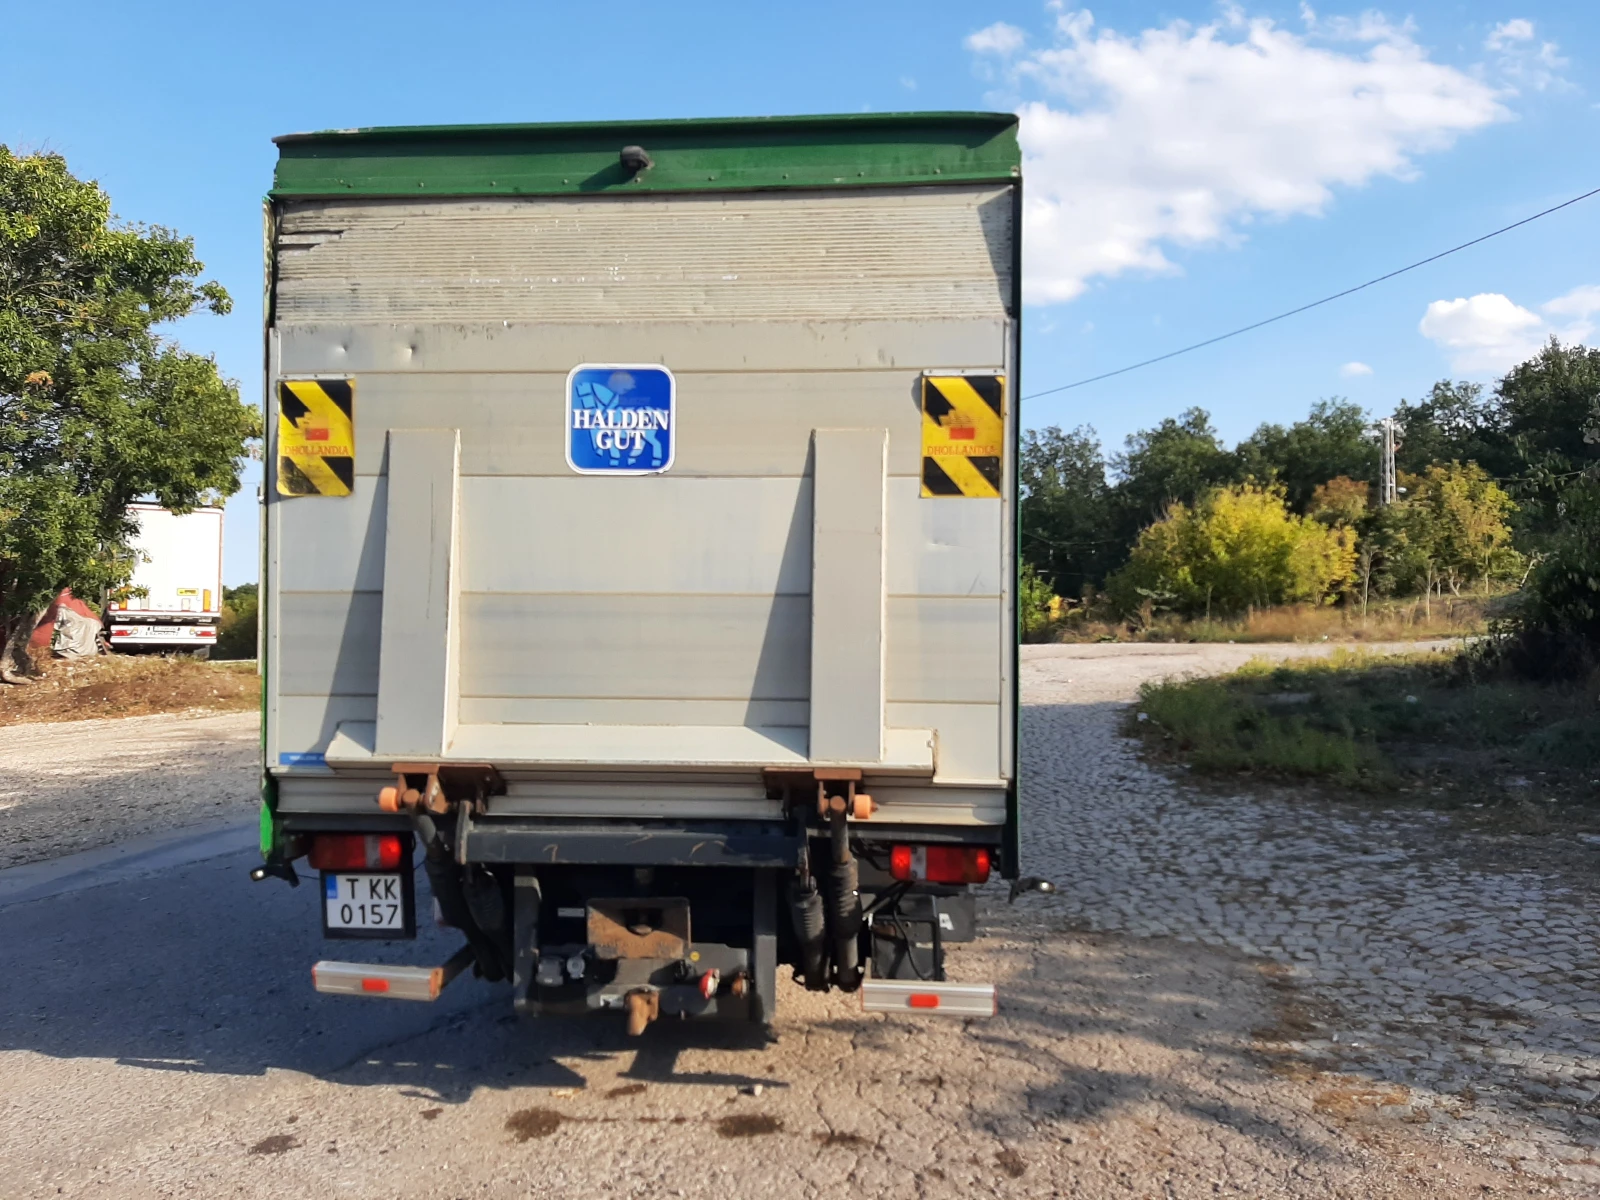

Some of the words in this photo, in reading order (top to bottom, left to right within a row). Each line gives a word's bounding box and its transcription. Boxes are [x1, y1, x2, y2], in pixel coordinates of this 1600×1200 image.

[572, 408, 669, 430] HALDEN
[284, 445, 349, 455] DHOLLANDIA
[596, 429, 646, 450] GUT
[926, 444, 997, 456] DHOLLANDIA
[345, 878, 359, 900] T
[369, 878, 398, 900] KK
[340, 903, 399, 926] 0157
